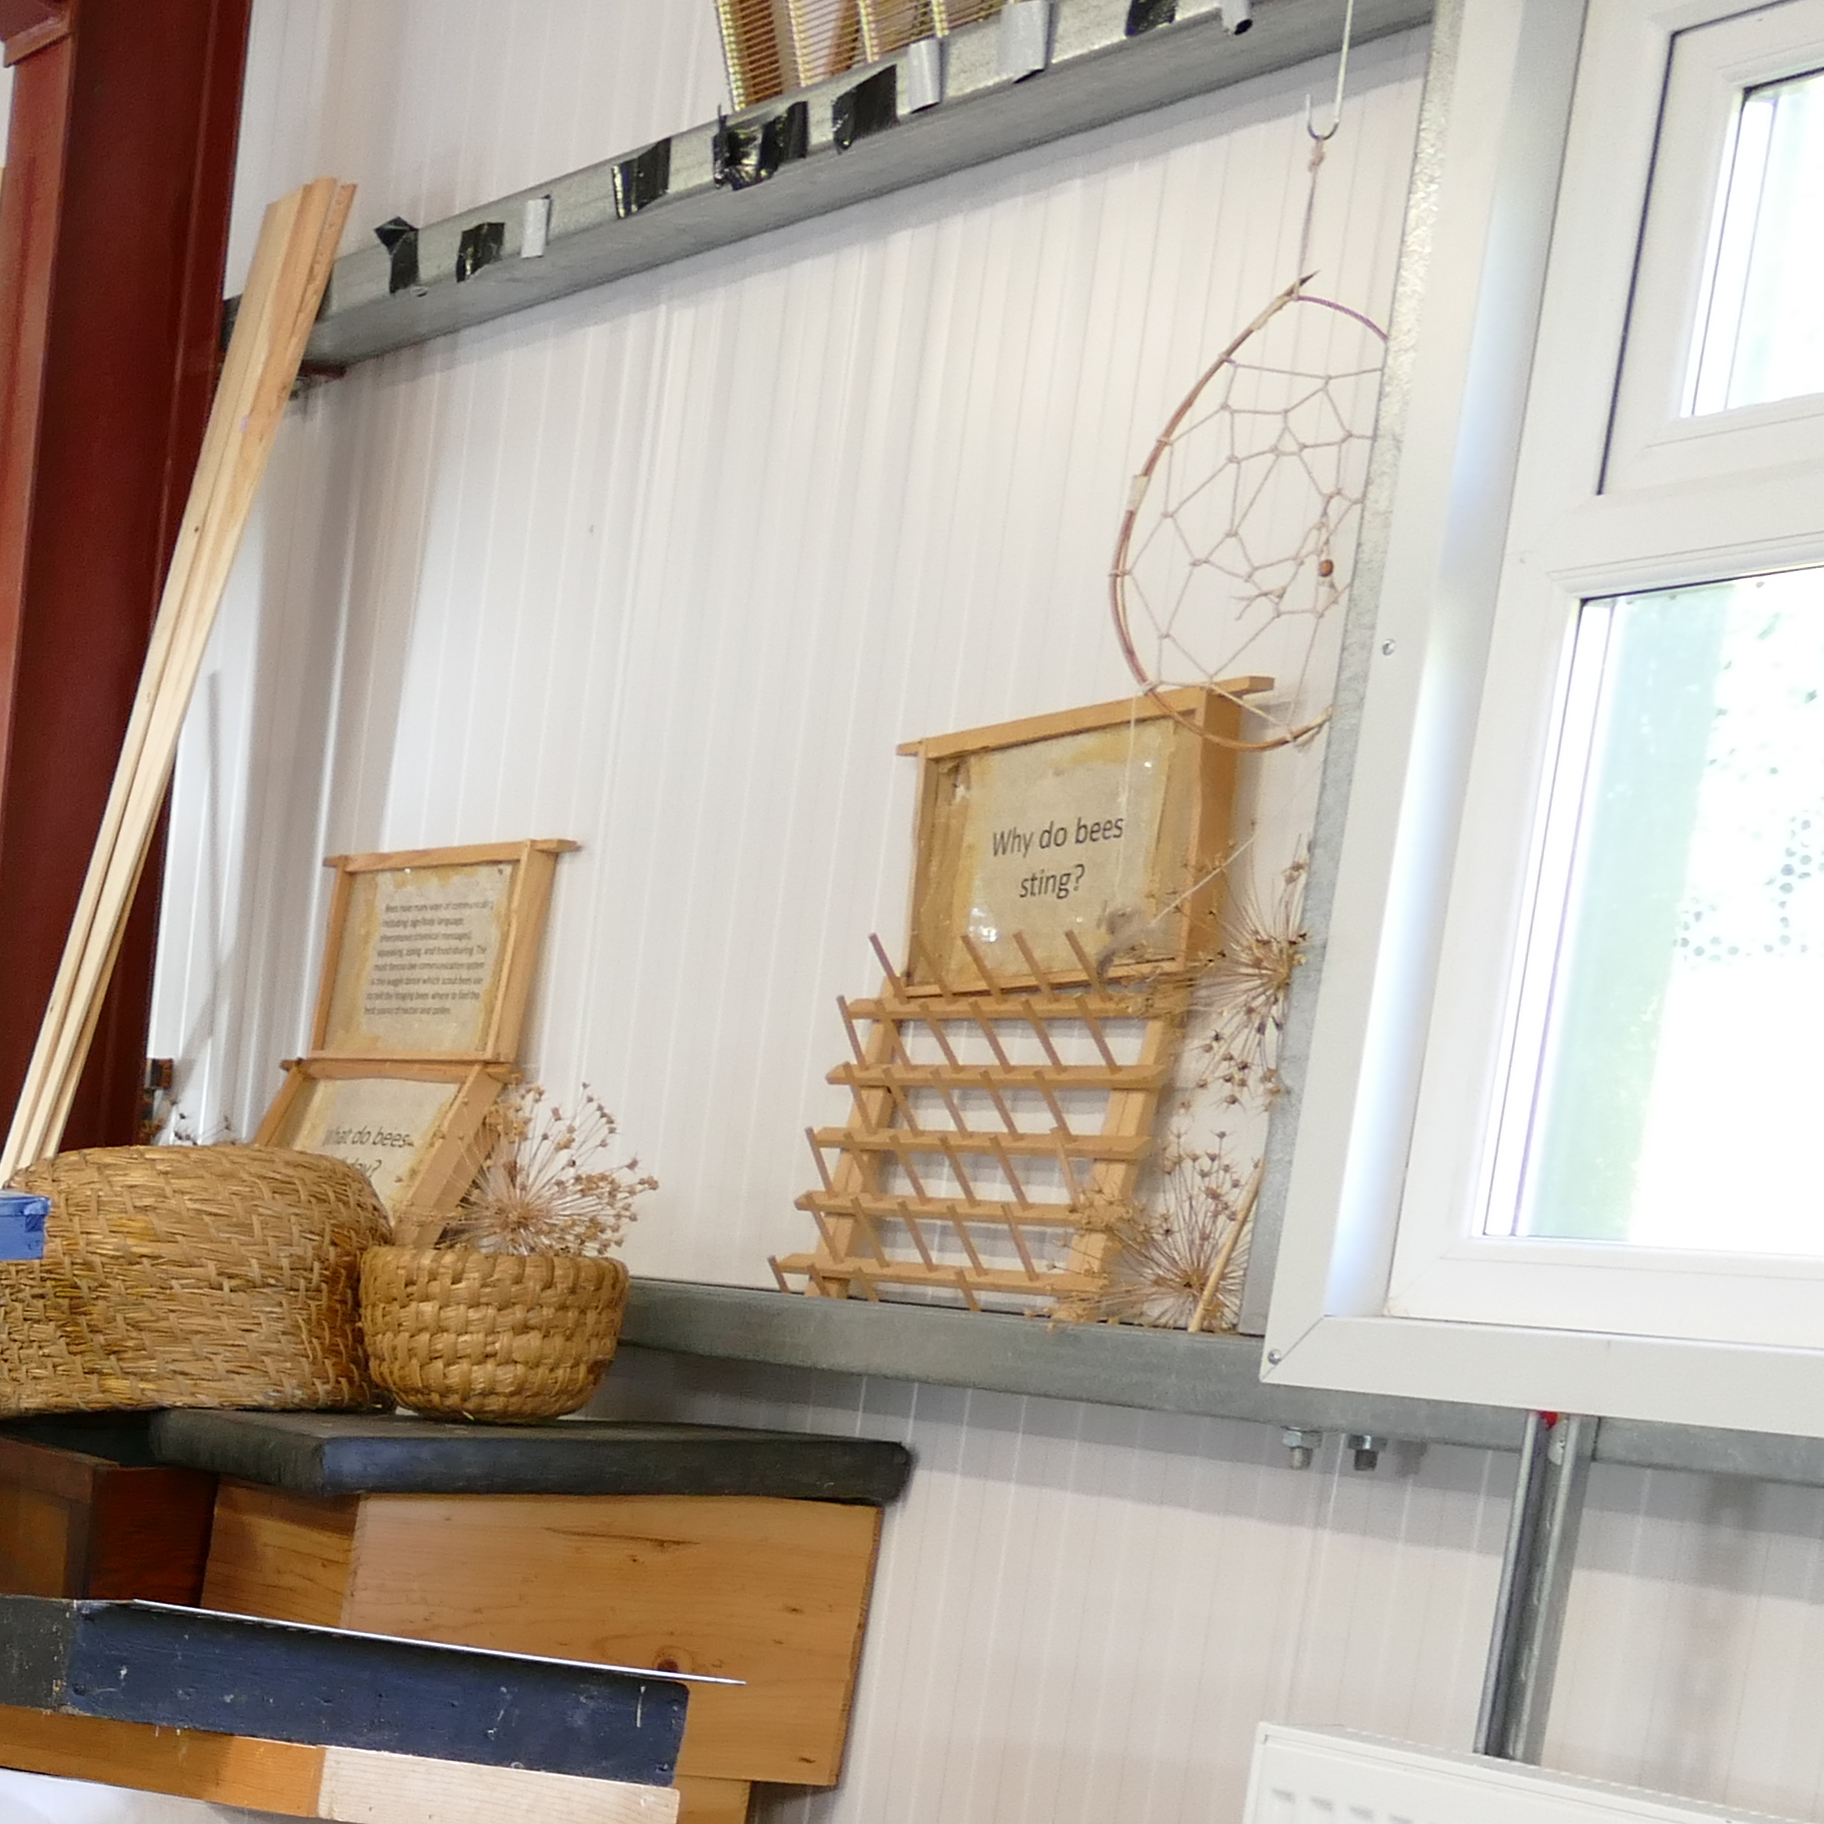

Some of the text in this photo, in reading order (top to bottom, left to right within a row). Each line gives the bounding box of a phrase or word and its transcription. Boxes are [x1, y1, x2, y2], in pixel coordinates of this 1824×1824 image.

[993, 816, 1123, 858] Why do bees
[1019, 864, 1086, 900] sting?
[352, 1125, 371, 1145] do
[372, 1126, 411, 1148] bees
